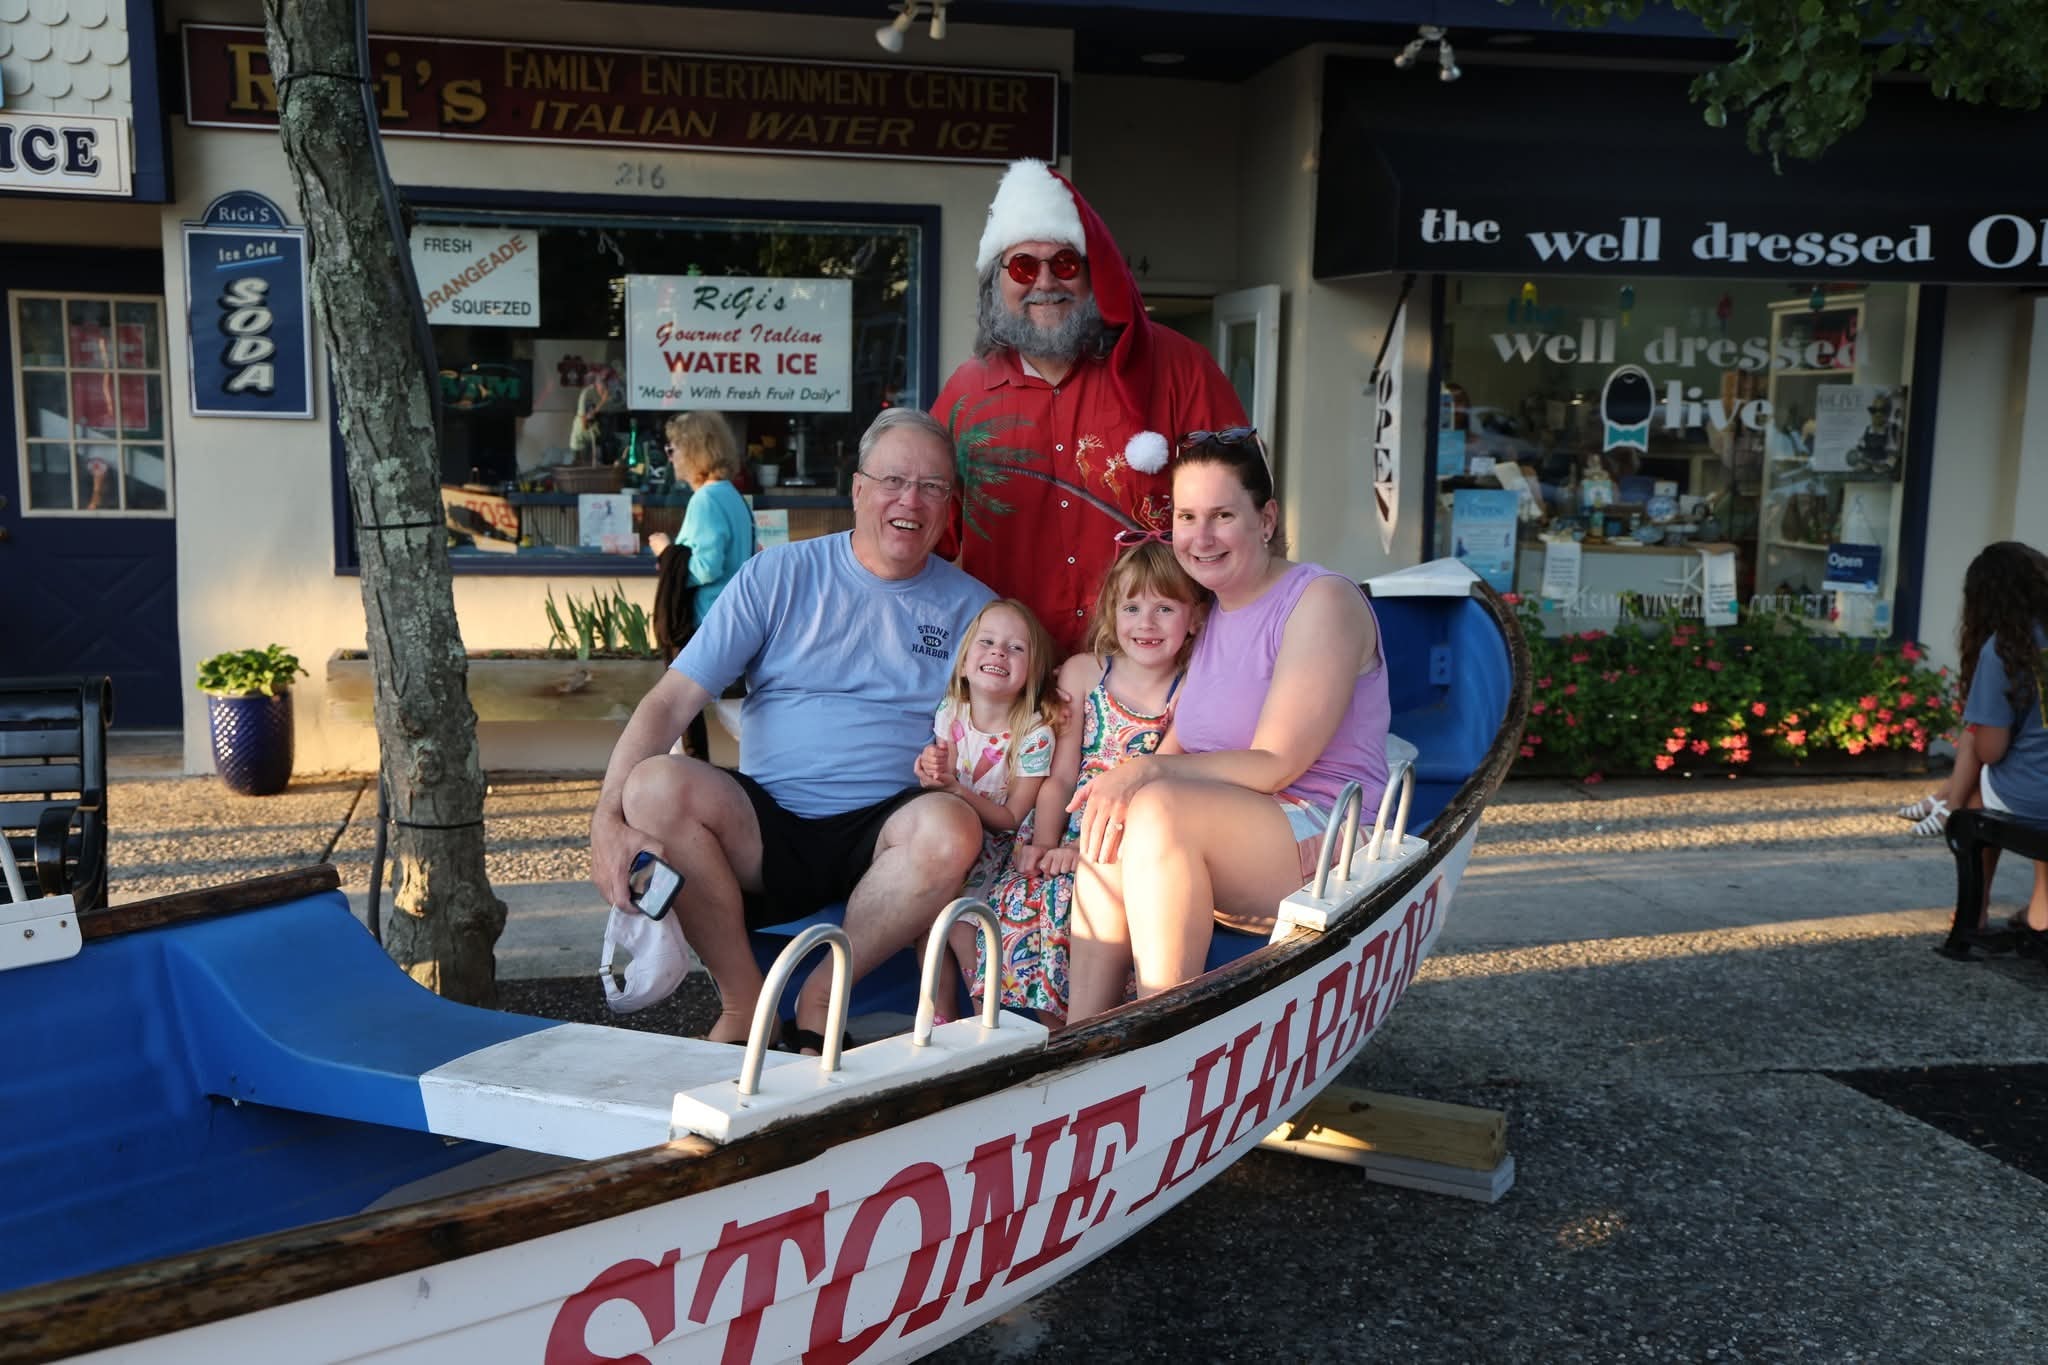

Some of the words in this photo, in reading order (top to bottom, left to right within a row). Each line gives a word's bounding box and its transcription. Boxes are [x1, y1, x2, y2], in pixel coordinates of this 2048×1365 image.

[226, 42, 487, 123] Ri's
[504, 48, 616, 93] FAMILY
[641, 54, 891, 106] ENTERTAINMENT
[904, 72, 1029, 113] CENTER
[530, 100, 718, 138] ITALIAN
[746, 111, 916, 147] WATER
[936, 120, 1016, 151] ICE
[614, 162, 666, 190] 216
[423, 237, 473, 253] FRESH
[1420, 208, 1501, 243] the
[1525, 216, 1661, 262] well
[1692, 220, 1936, 267] dressed
[218, 247, 241, 263] Ice
[245, 240, 278, 259] Cold
[451, 299, 532, 316] SQUEEZED
[222, 276, 276, 393] SODA
[656, 320, 743, 347] Gourmet
[750, 323, 823, 345] Italian
[1490, 319, 1617, 364] well
[1644, 326, 1869, 371] dressed
[663, 351, 762, 375] WATER
[777, 353, 818, 375] ICE
[690, 386, 722, 400] With
[726, 387, 757, 401] Fresh
[766, 387, 796, 401] Fruit
[1828, 553, 1863, 568] Open
[917, 625, 950, 640] STONE
[911, 643, 950, 661] HARBOR
[545, 1085, 1147, 1365] STONE
[1126, 875, 1442, 1217] HARBOR
